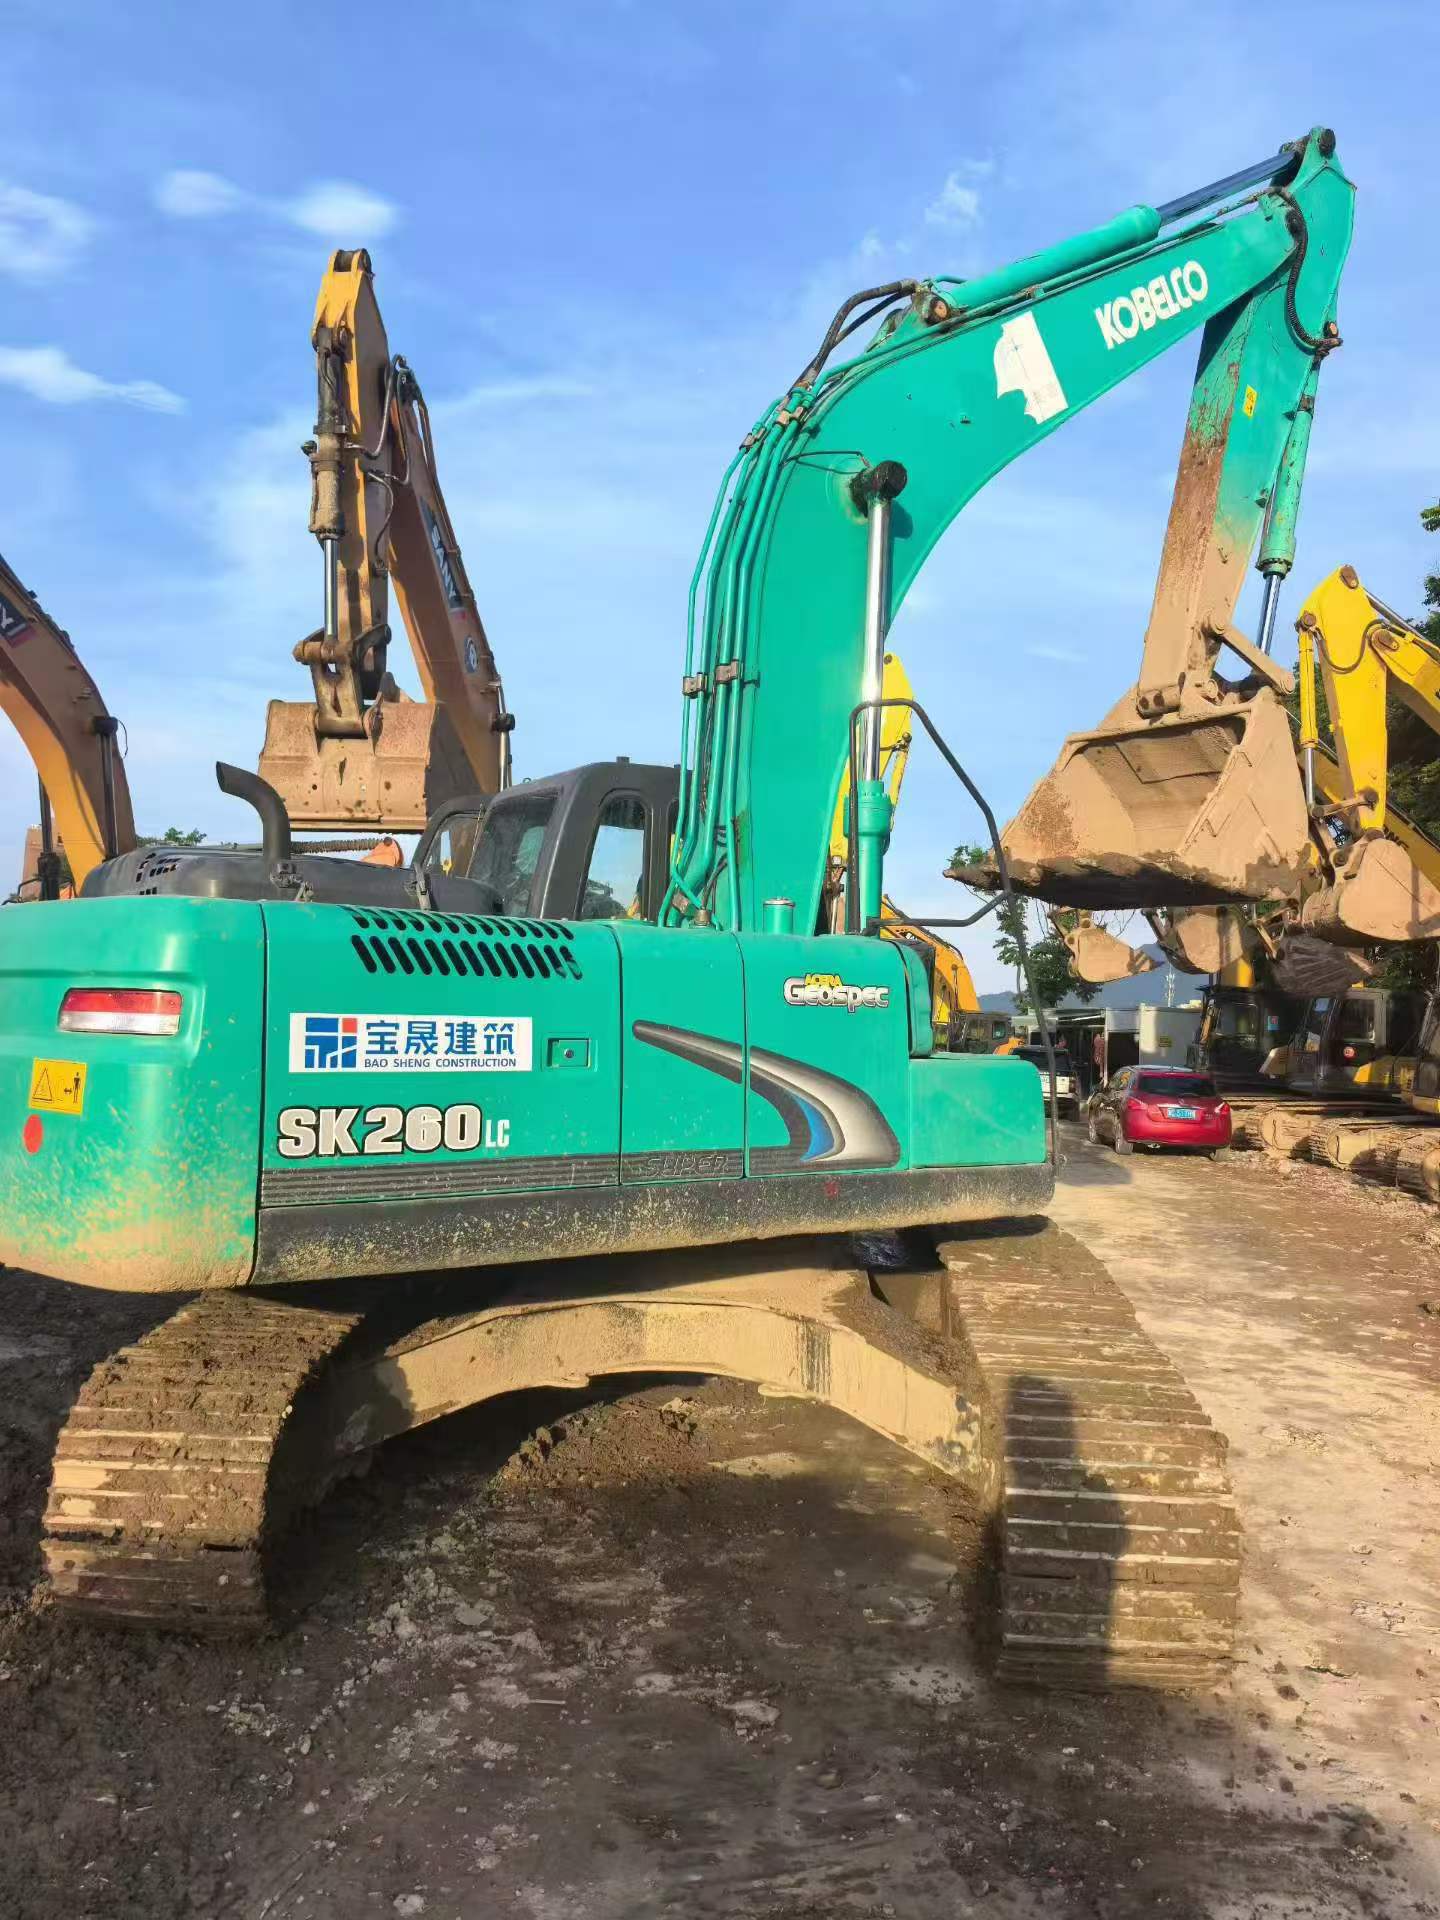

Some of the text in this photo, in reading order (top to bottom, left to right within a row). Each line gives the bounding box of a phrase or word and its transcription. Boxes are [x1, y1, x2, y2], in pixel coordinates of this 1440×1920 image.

[1094, 260, 1208, 350] KOBELCO
[361, 1020, 515, 1055] 宝晟建筑
[364, 1058, 517, 1068] BAO SHENG CONSTRUCTION
[277, 1103, 511, 1159] SK260 LC
